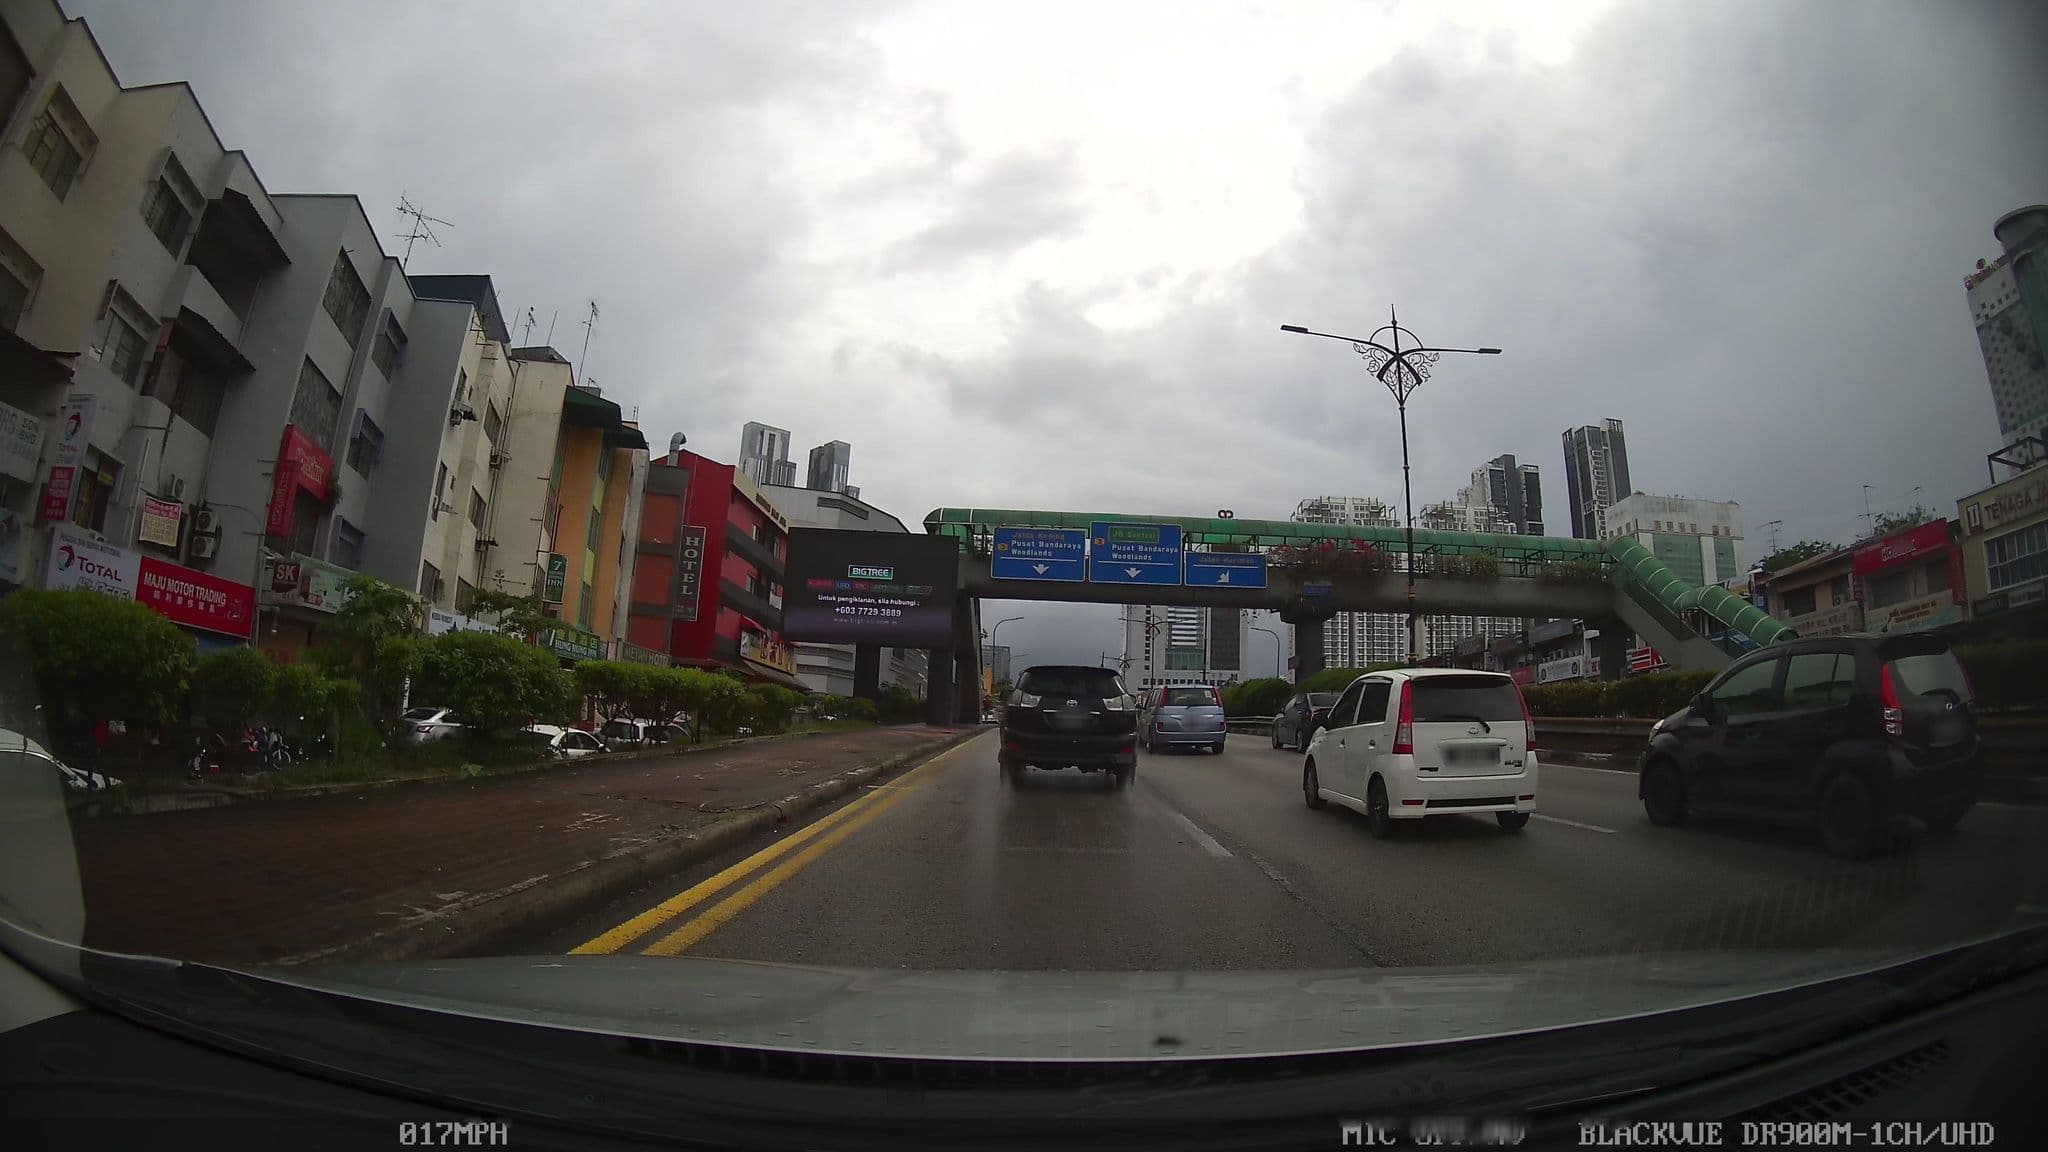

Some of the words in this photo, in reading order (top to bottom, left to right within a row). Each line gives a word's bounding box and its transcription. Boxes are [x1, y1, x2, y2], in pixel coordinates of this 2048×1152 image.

[1984, 487, 2033, 521] TENAGA
[1011, 548, 1052, 557] Woodlands
[1038, 541, 1082, 550] Bandaraya
[1112, 544, 1135, 552] Pusat
[1138, 545, 1179, 554] Bandaraya
[1112, 553, 1152, 561] Woodlands
[77, 556, 122, 582] TOTAL
[276, 564, 296, 581] SK
[681, 536, 699, 595] HOTEL
[144, 571, 167, 590] MAJU
[167, 579, 195, 598] MOTOR
[195, 585, 227, 606] TRADING
[834, 606, 856, 616] +603
[857, 607, 879, 617] 7729
